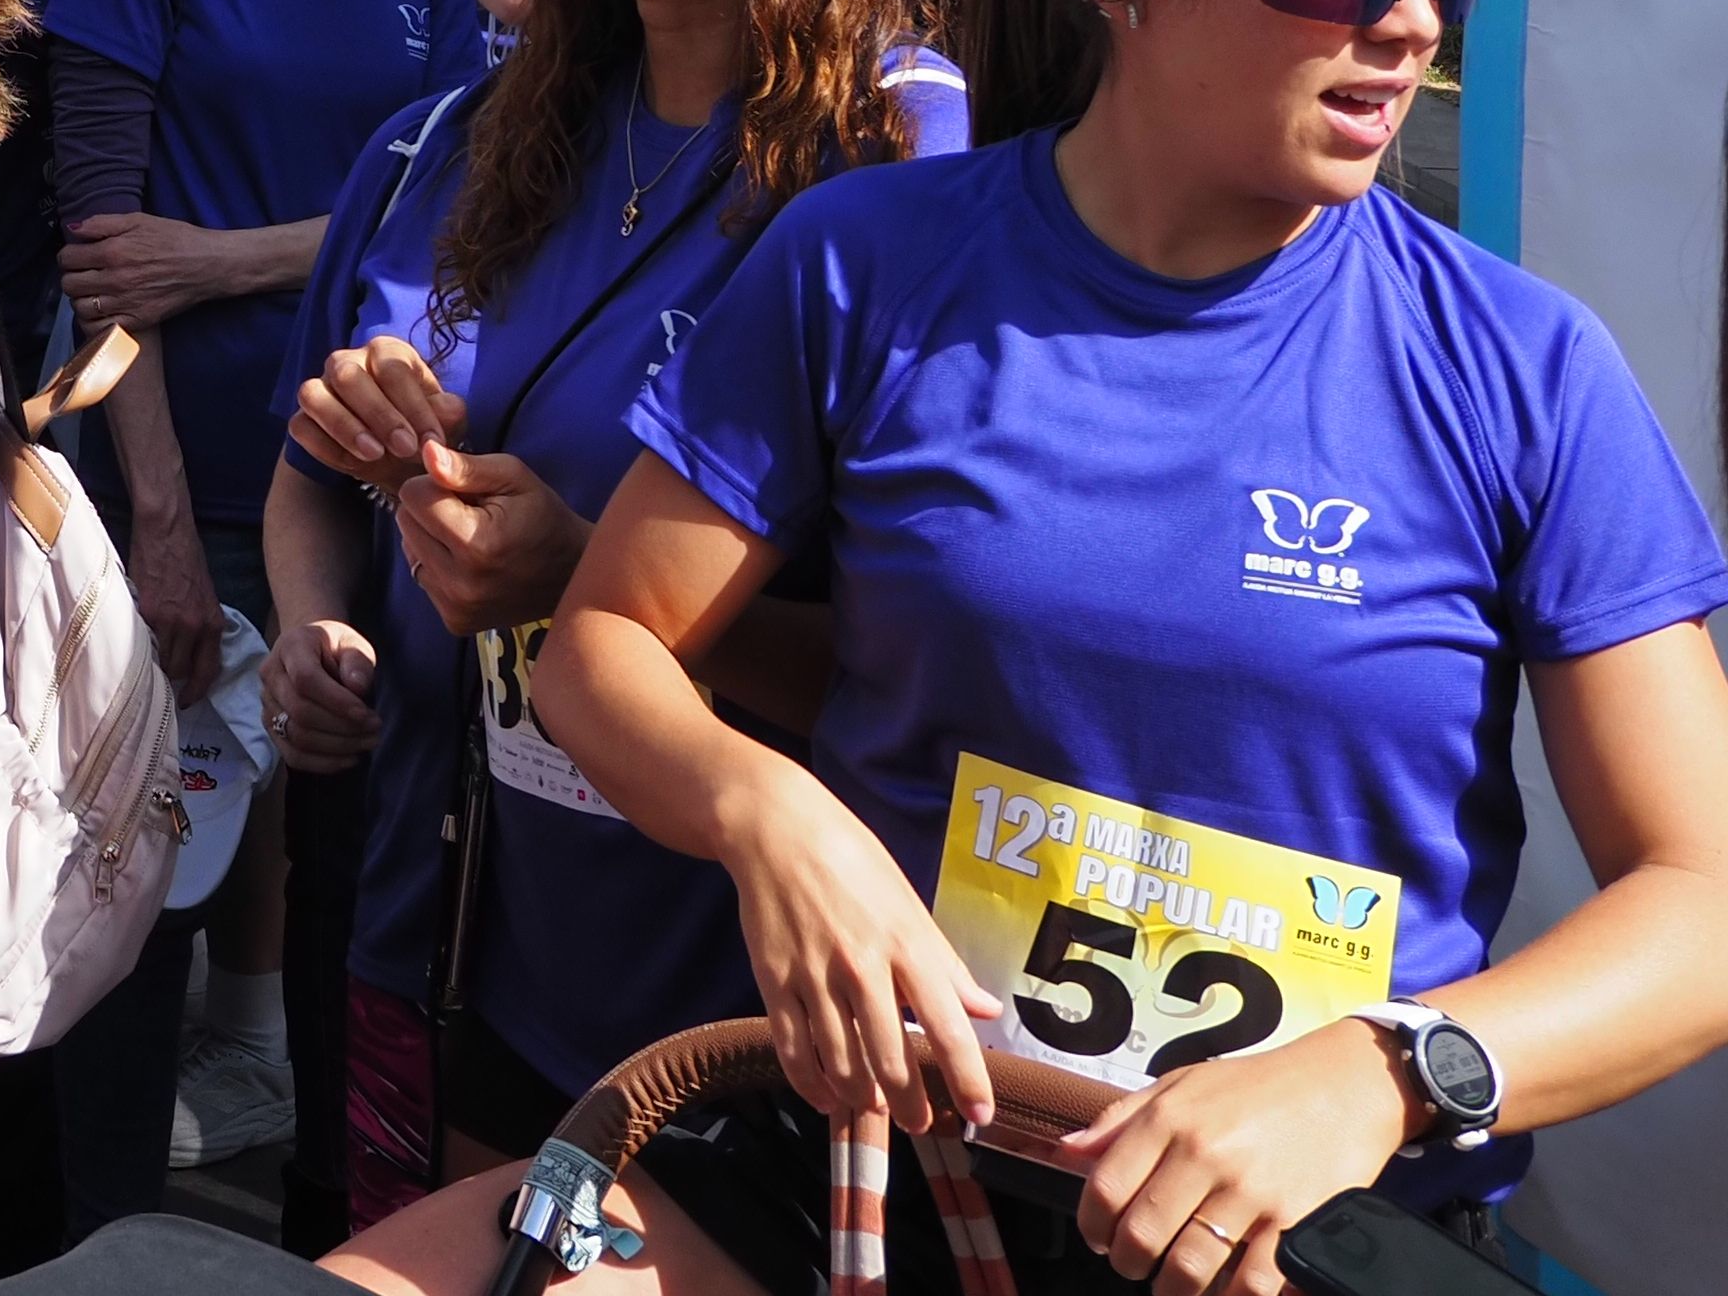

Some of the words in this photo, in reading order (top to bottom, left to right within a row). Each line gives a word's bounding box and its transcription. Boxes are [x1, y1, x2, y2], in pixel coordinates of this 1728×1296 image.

[1245, 553, 1312, 579] marc
[1317, 563, 1363, 590] g.g.
[1083, 812, 1191, 878] MARXA
[1074, 855, 1283, 952] POPULAR
[1296, 929, 1339, 949] marc
[1346, 941, 1374, 960] g.g.
[1012, 901, 1284, 1078] 52
